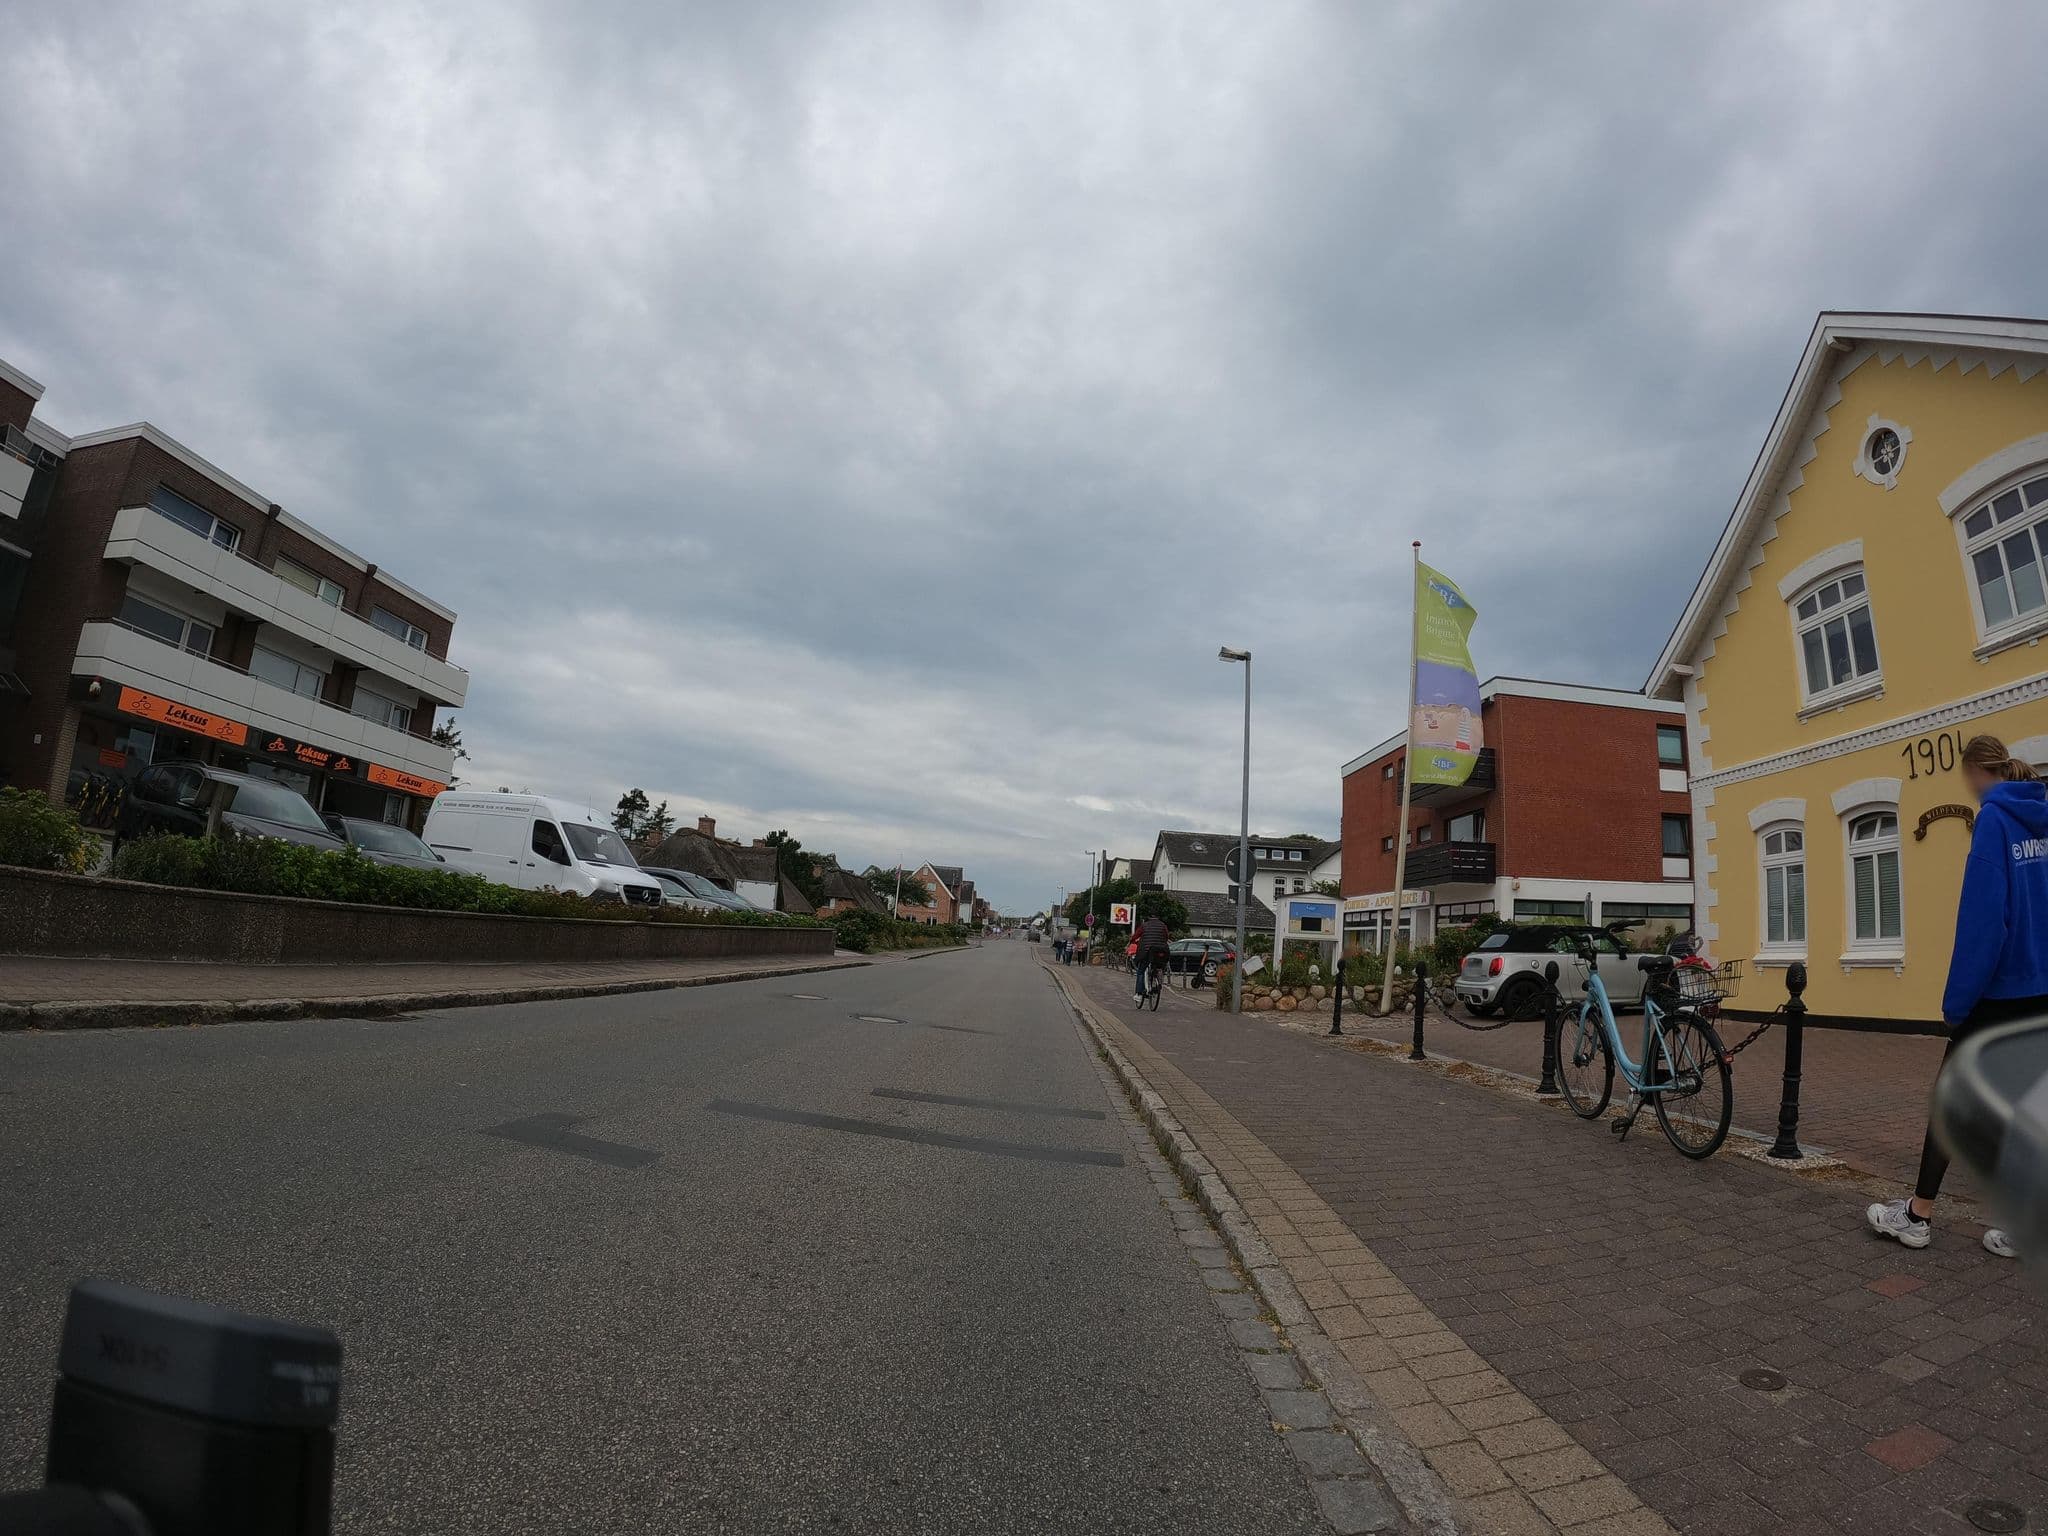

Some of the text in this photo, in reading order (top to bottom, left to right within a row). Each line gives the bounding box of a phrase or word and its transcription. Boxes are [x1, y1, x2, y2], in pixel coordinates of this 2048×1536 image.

[166, 704, 208, 726] Leksus
[294, 743, 329, 761] Leksus
[396, 774, 423, 788] Leksus
